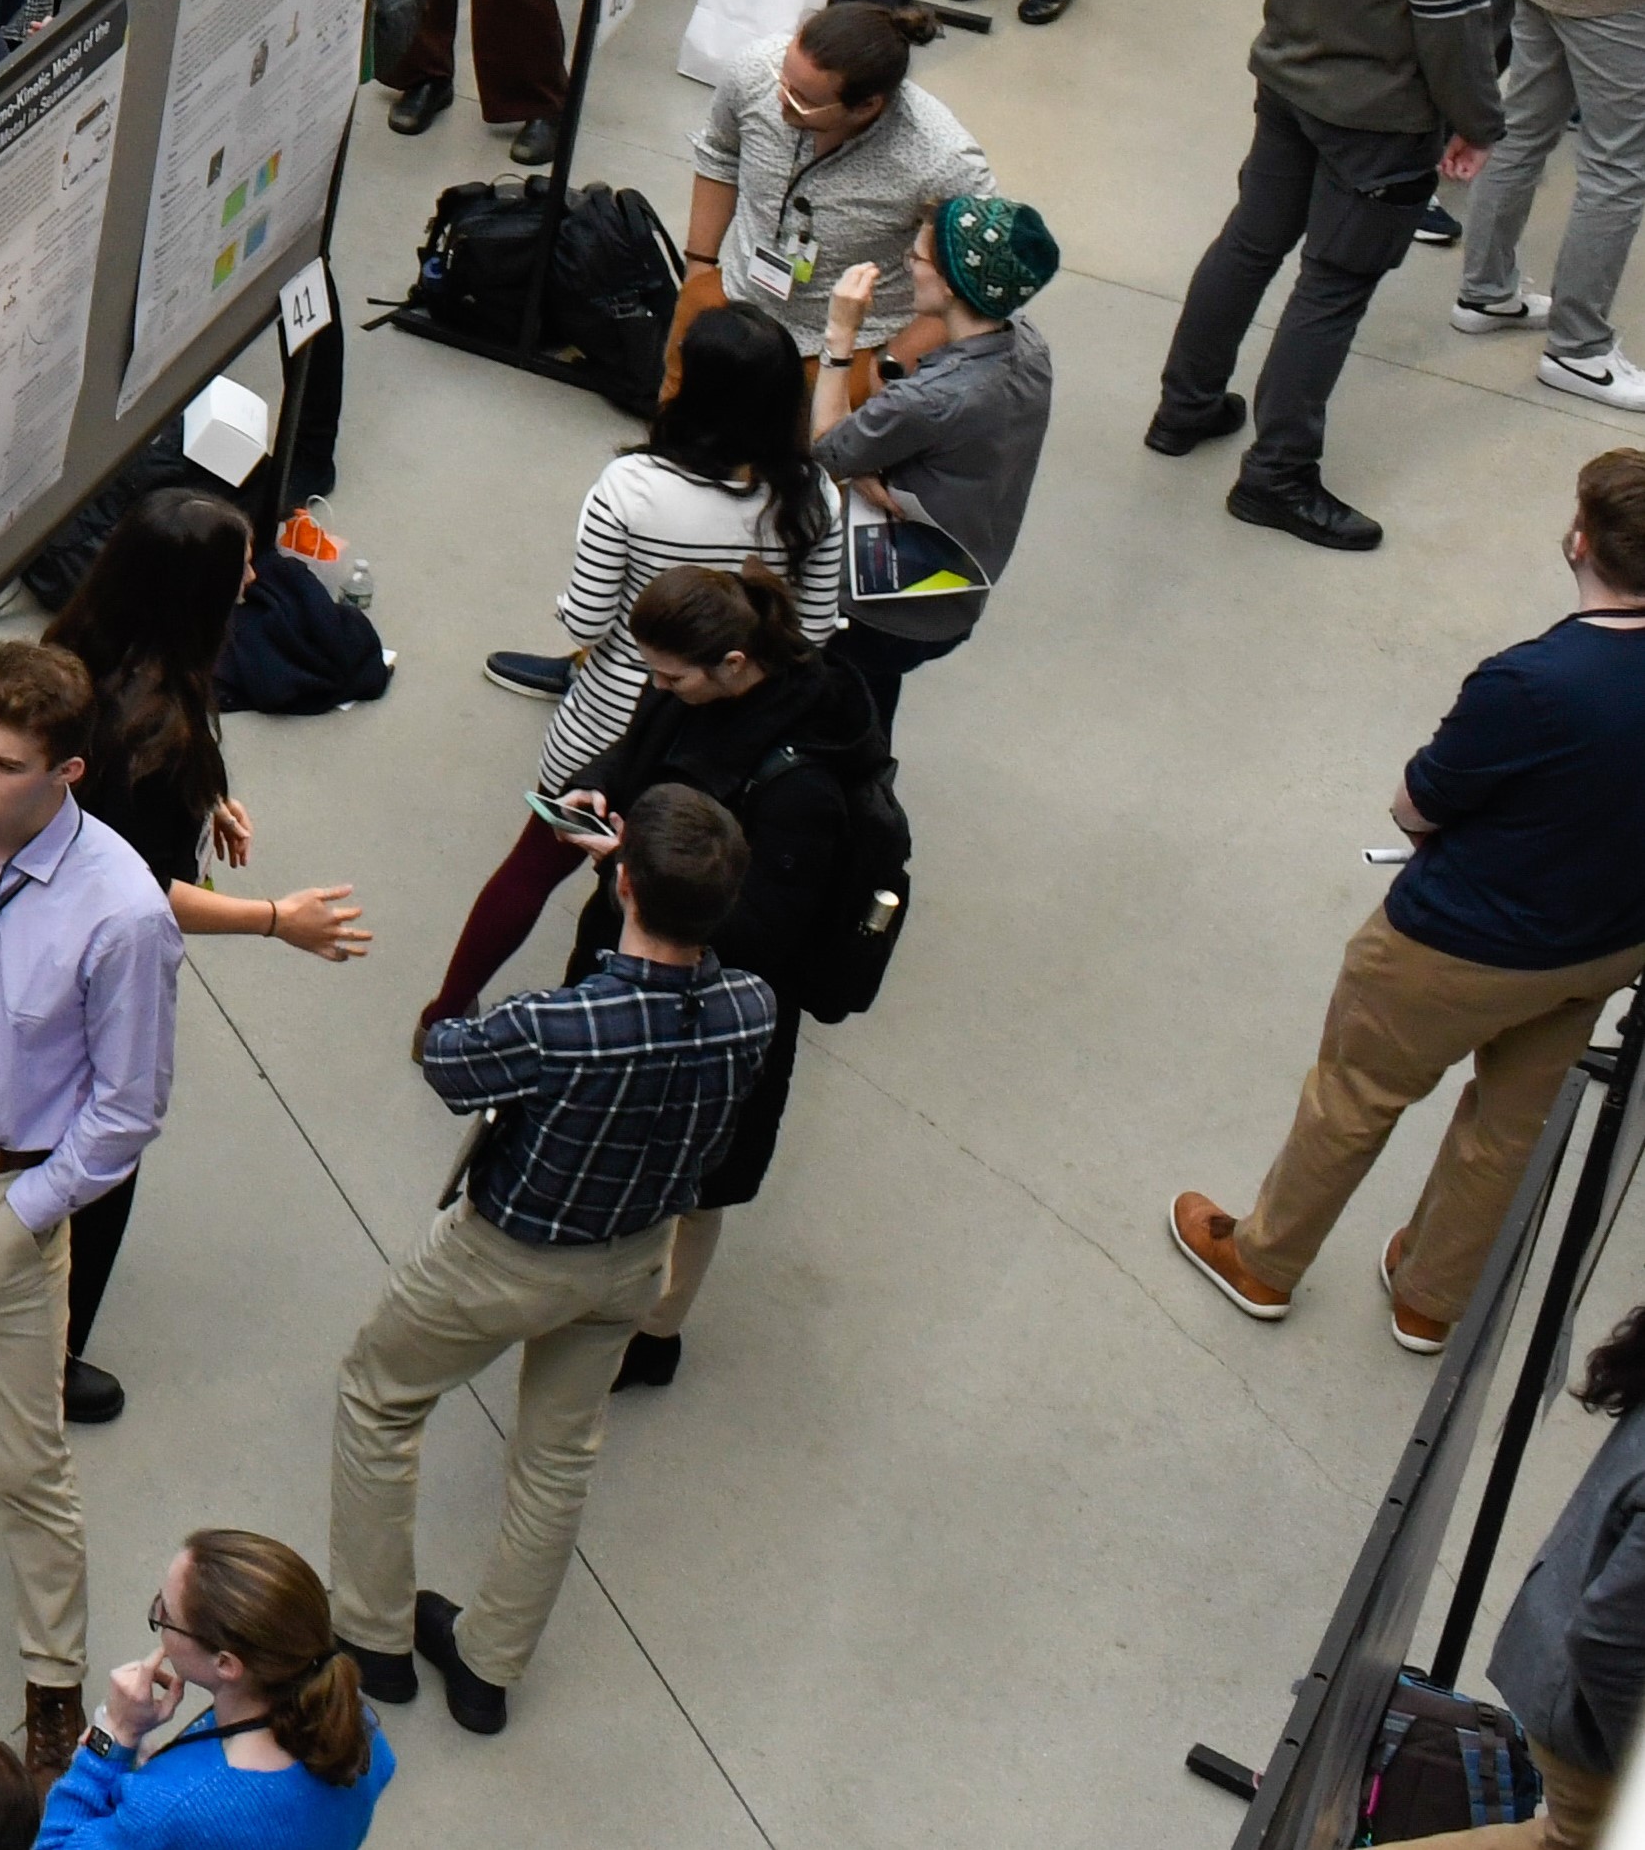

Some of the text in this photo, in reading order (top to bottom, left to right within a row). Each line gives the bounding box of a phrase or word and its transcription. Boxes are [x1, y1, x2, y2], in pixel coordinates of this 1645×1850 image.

[52, 39, 81, 81] Model
[83, 29, 93, 54] of
[95, 15, 110, 43] the
[0, 112, 26, 147] Metal
[28, 103, 36, 124] in
[39, 64, 83, 115] Seawater
[293, 286, 316, 330] 41
